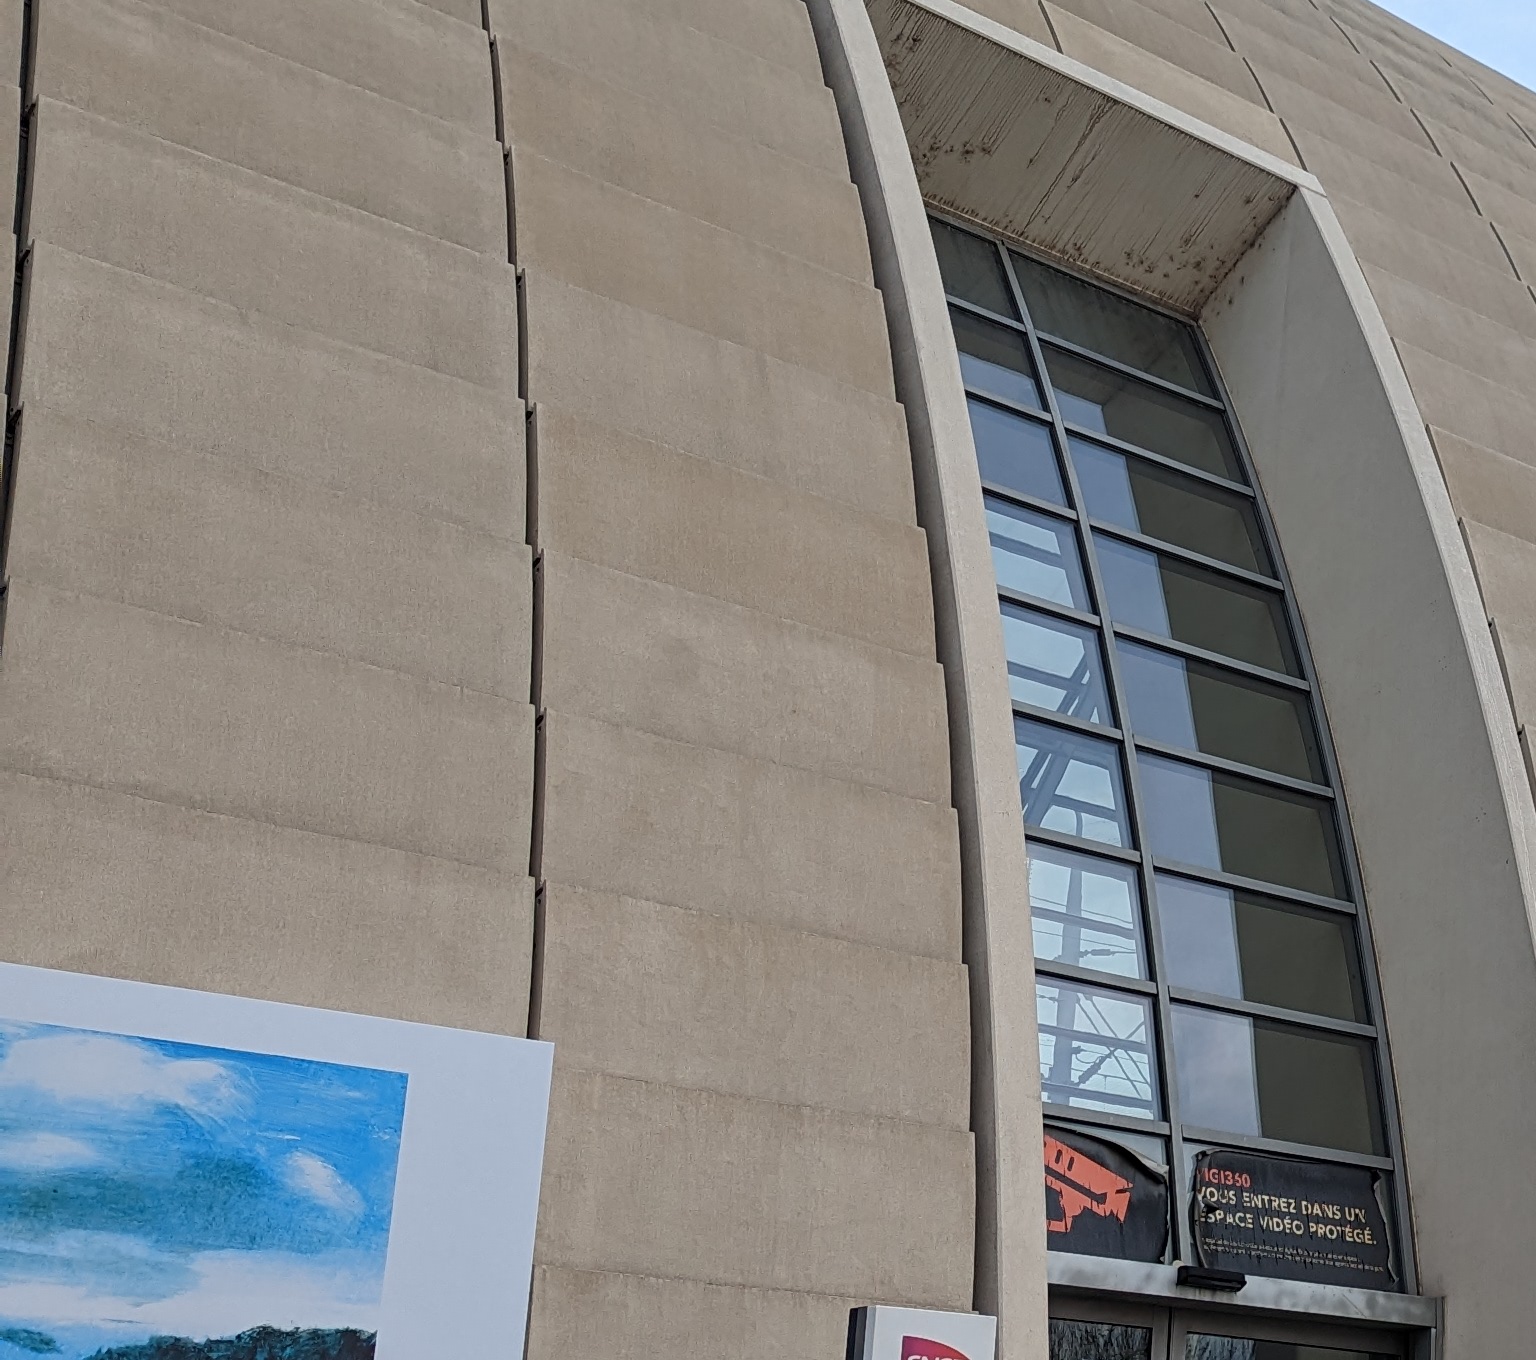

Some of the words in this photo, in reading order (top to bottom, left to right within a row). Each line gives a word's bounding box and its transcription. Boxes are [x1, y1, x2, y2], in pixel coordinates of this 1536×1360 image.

[1242, 1192, 1297, 1214] ENTREZ
[1301, 1200, 1342, 1220] DANS
[1344, 1205, 1367, 1224] UN
[1260, 1214, 1305, 1236] VIDÉO
